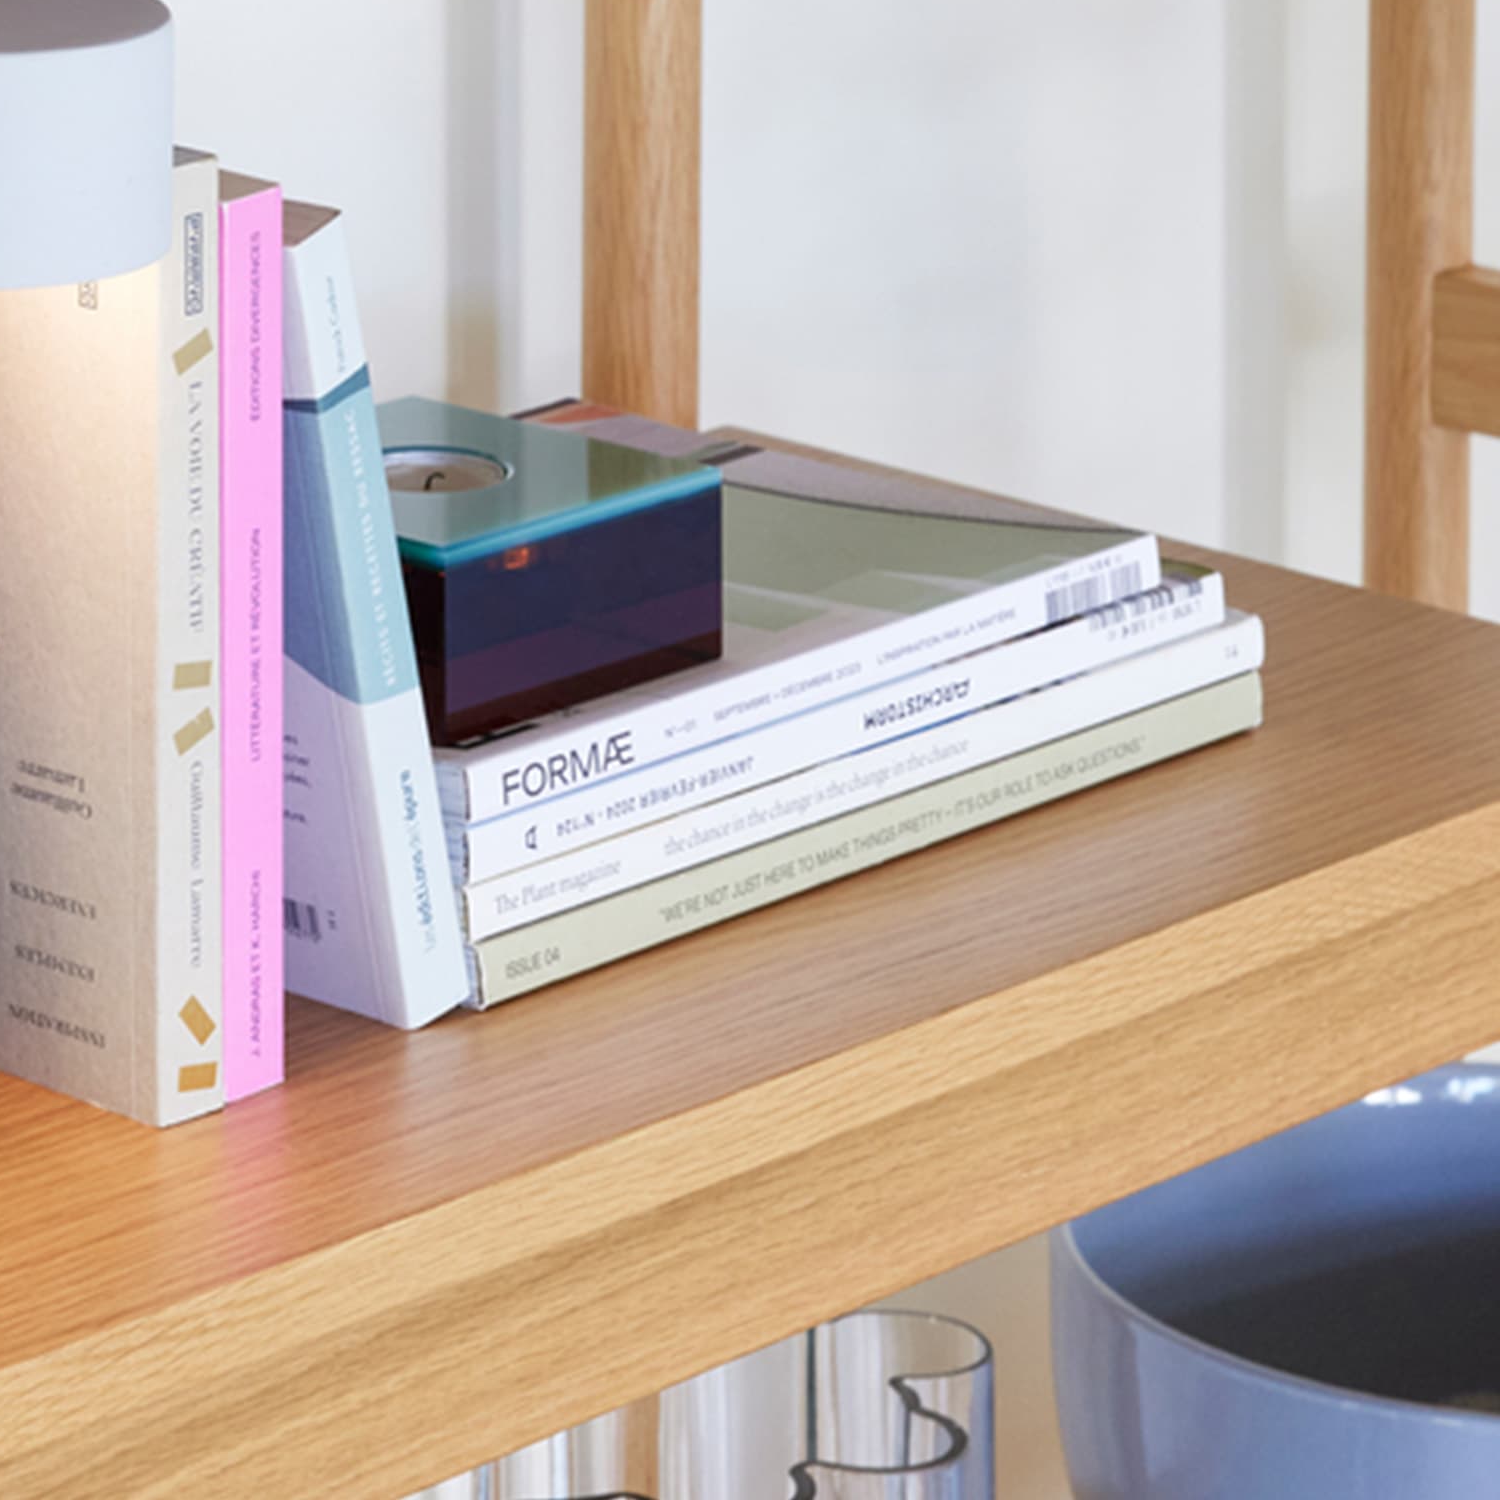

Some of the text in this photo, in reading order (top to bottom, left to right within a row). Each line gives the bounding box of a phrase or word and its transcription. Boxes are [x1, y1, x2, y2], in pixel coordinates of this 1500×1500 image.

[249, 230, 260, 342] DIVERGENCES
[188, 381, 202, 413] LA
[188, 419, 202, 480] VOIE
[188, 486, 202, 519] DU
[250, 634, 260, 653] ET
[863, 677, 968, 731] ARCHISTORM
[502, 730, 633, 806] FORMÆ
[606, 796, 634, 821] 2024
[703, 885, 729, 910] NOT
[731, 874, 761, 900] JUST
[763, 860, 795, 888] HERE
[797, 853, 815, 876] TO
[817, 841, 849, 869] MAKE
[852, 824, 896, 855] THINGS
[898, 808, 941, 839] PRETTY
[977, 786, 1002, 810] OUR
[1004, 775, 1031, 800] ROLE
[1035, 768, 1051, 789] TO
[1053, 761, 1072, 782] ASK
[494, 860, 620, 916] The Plant magazine
[250, 953, 260, 972] ET
[504, 946, 559, 981] ISSUE 04
[8, 1003, 105, 1049] INSPIRATION
